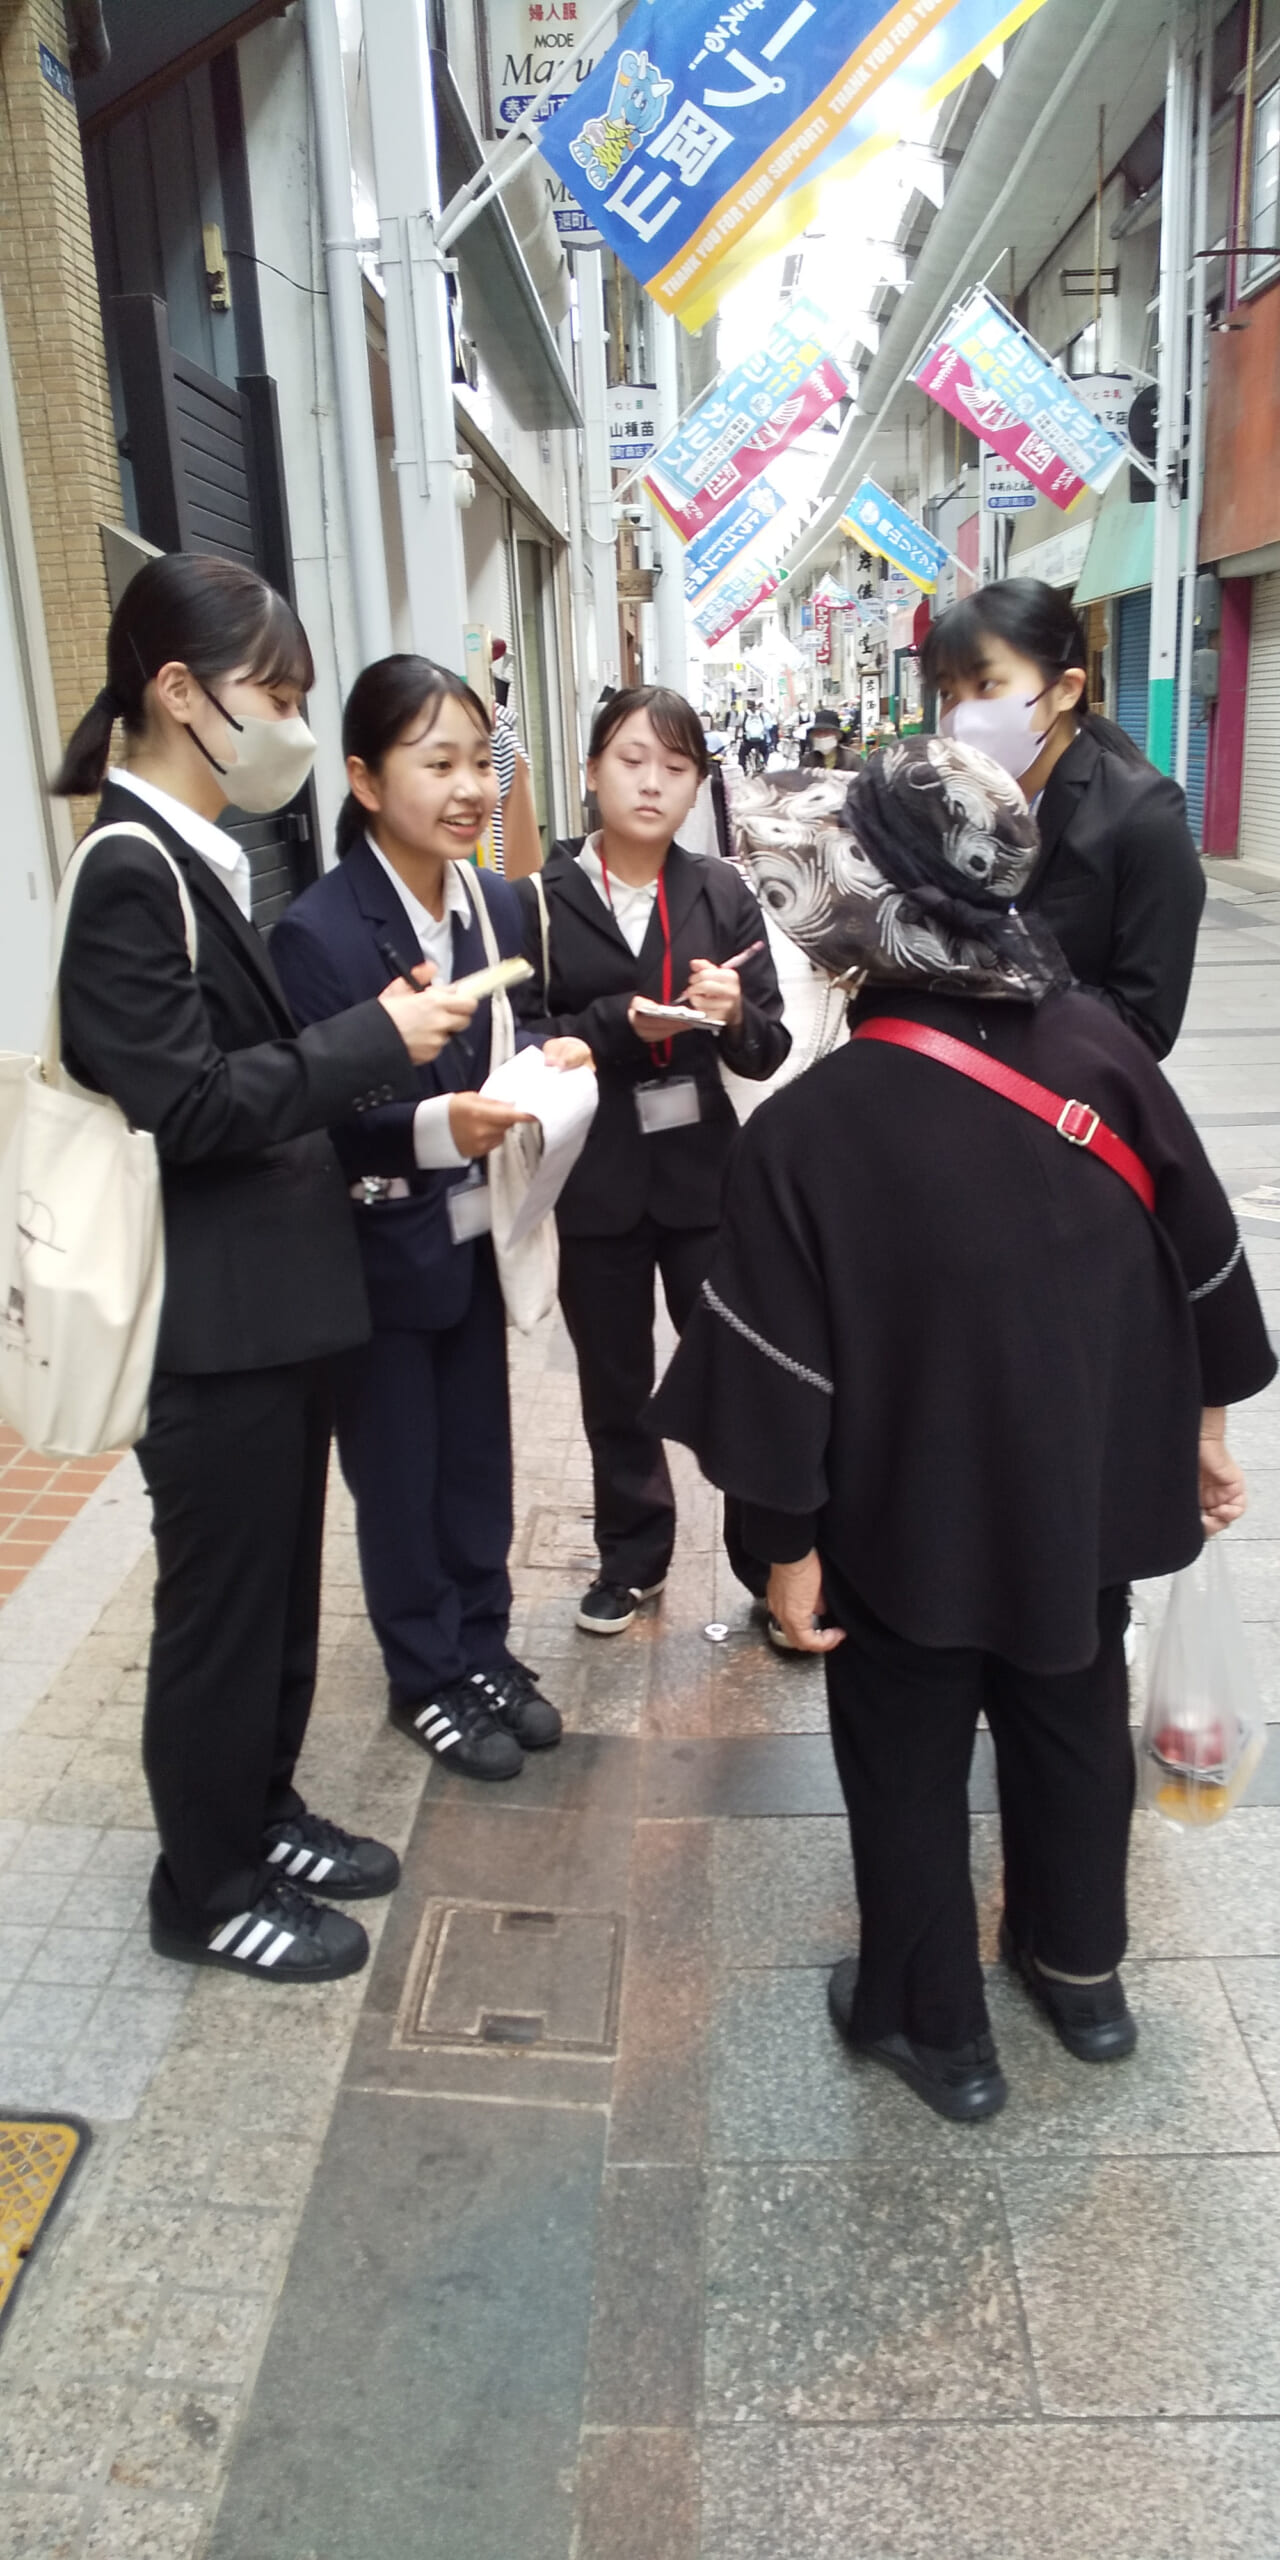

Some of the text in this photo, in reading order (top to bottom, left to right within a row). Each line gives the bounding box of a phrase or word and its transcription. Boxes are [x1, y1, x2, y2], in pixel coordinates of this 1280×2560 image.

[528, 2, 578, 21] 婦人服
[534, 33, 575, 48] MODE
[660, 254, 702, 297] THANK
[696, 227, 722, 259] YOU
[715, 206, 744, 236] FOR
[738, 174, 774, 212] YOUR
[767, 116, 830, 180] SUPPORT!
[828, 64, 872, 115] THANK
[864, 38, 896, 71] YOU
[888, 13, 919, 46] FOR
[664, 316, 814, 474] 山シーガルズ
[609, 421, 655, 438] 山種苗
